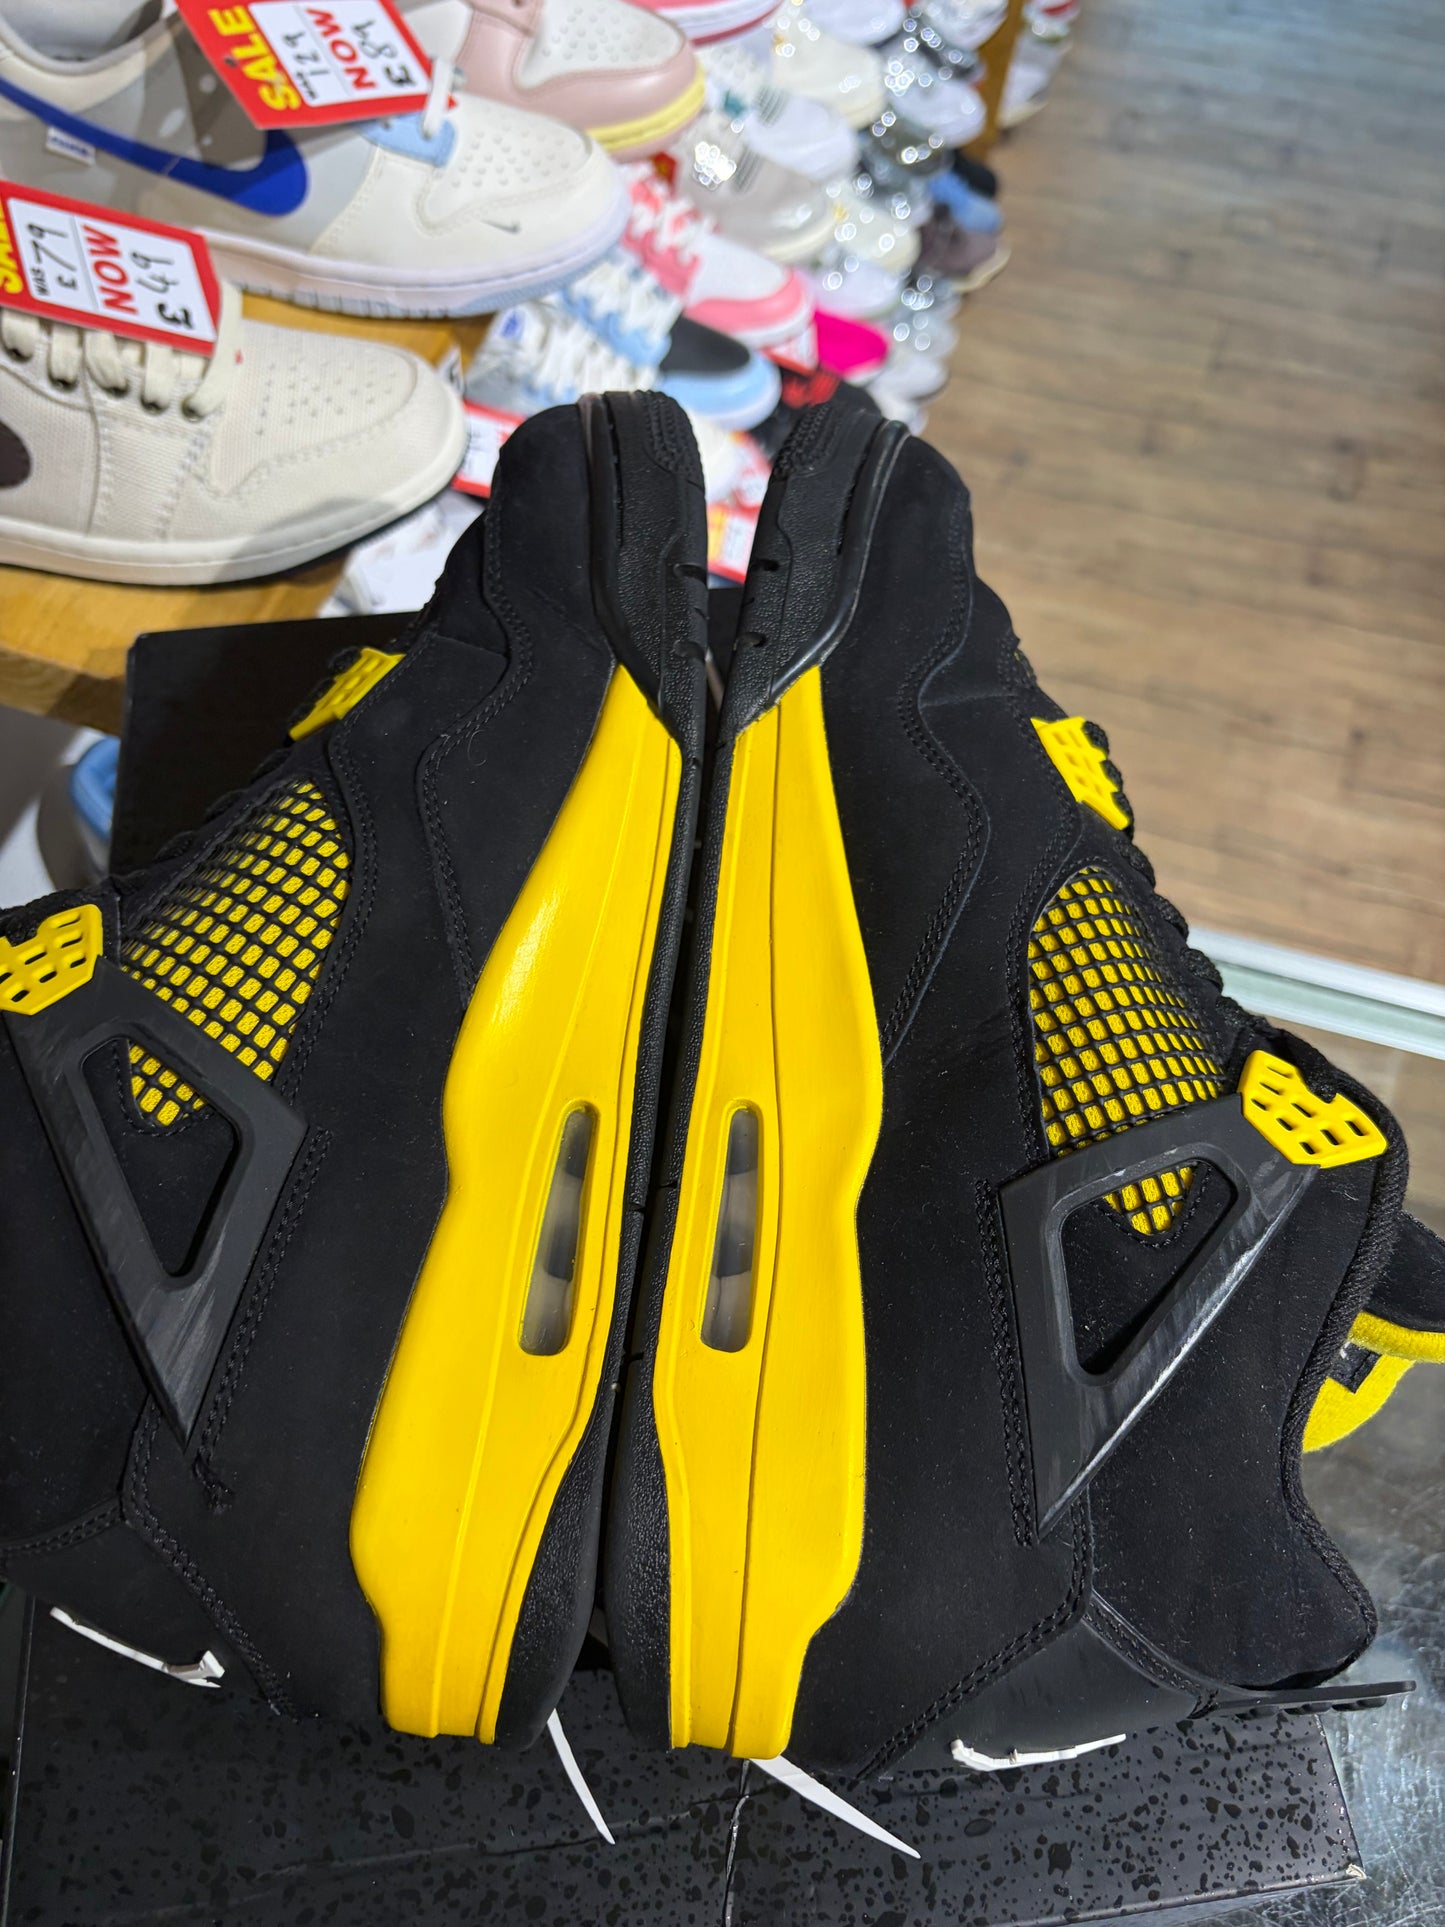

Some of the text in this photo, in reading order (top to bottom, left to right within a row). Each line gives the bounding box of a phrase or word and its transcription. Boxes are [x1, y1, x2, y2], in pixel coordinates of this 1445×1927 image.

[208, 5, 301, 110] SALE
[306, 8, 376, 90] NOW
[27, 223, 77, 290] £79
[31, 267, 49, 297] WAS
[82, 225, 139, 315] NOW
[130, 251, 195, 331] £49
